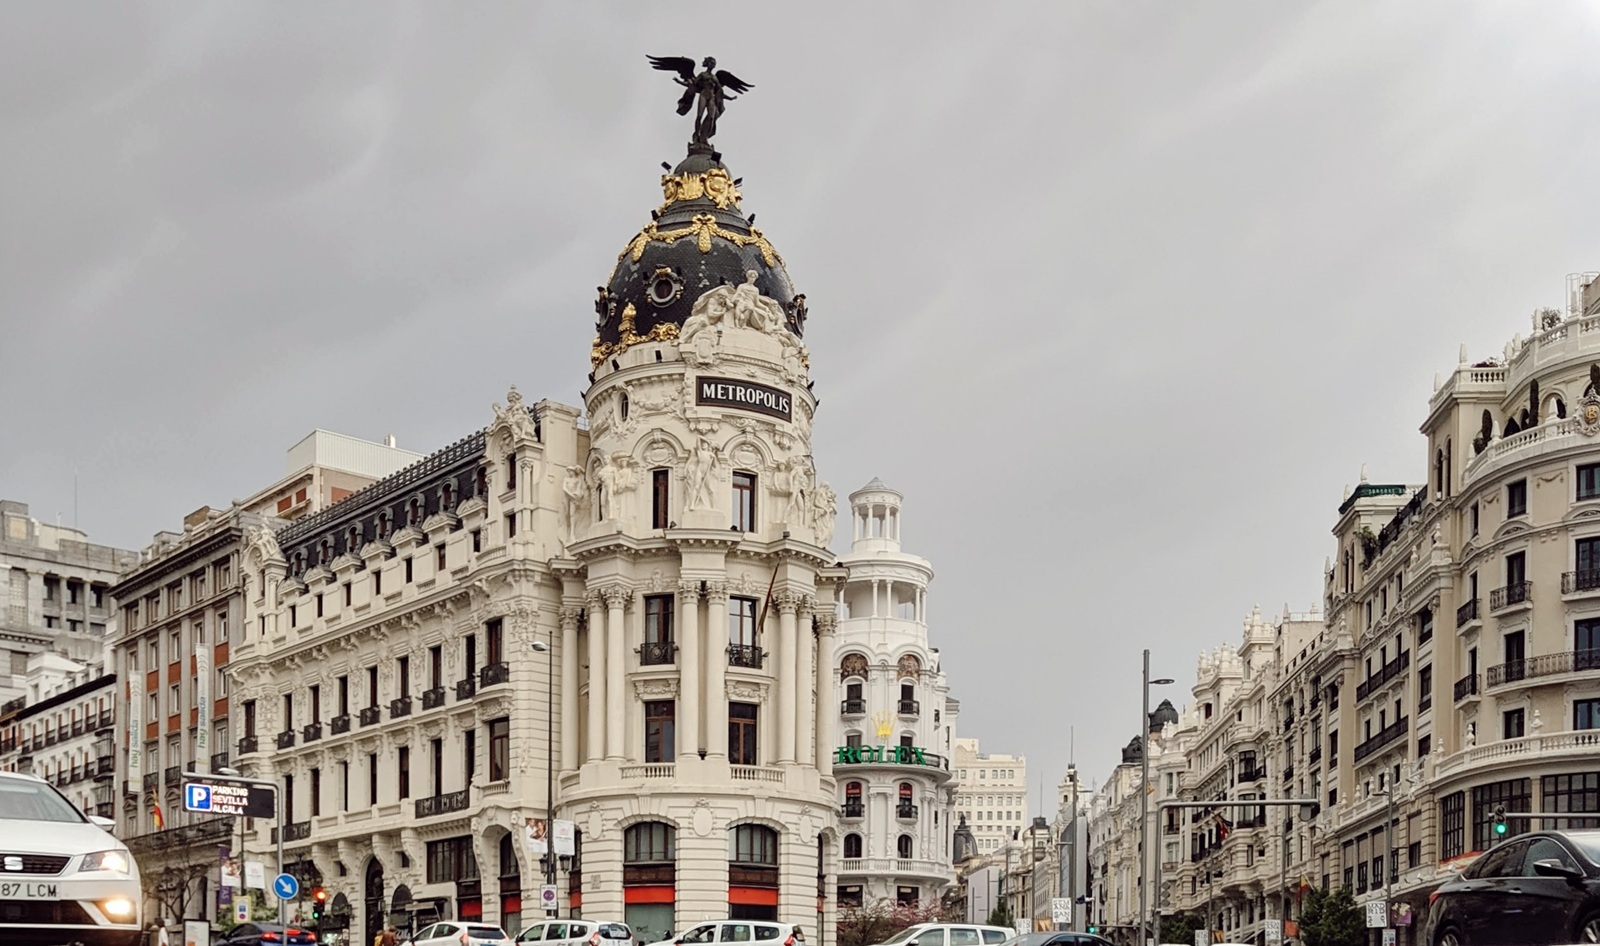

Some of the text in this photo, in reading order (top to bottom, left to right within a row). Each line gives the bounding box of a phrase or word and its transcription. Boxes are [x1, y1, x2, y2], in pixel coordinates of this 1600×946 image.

[702, 383, 790, 414] METROPOLIS
[837, 745, 927, 766] ROLEX
[212, 785, 248, 797] PARKING
[212, 795, 248, 806] SEVILLA
[212, 804, 244, 815] ALCALA
[27, 883, 57, 898] LCM
